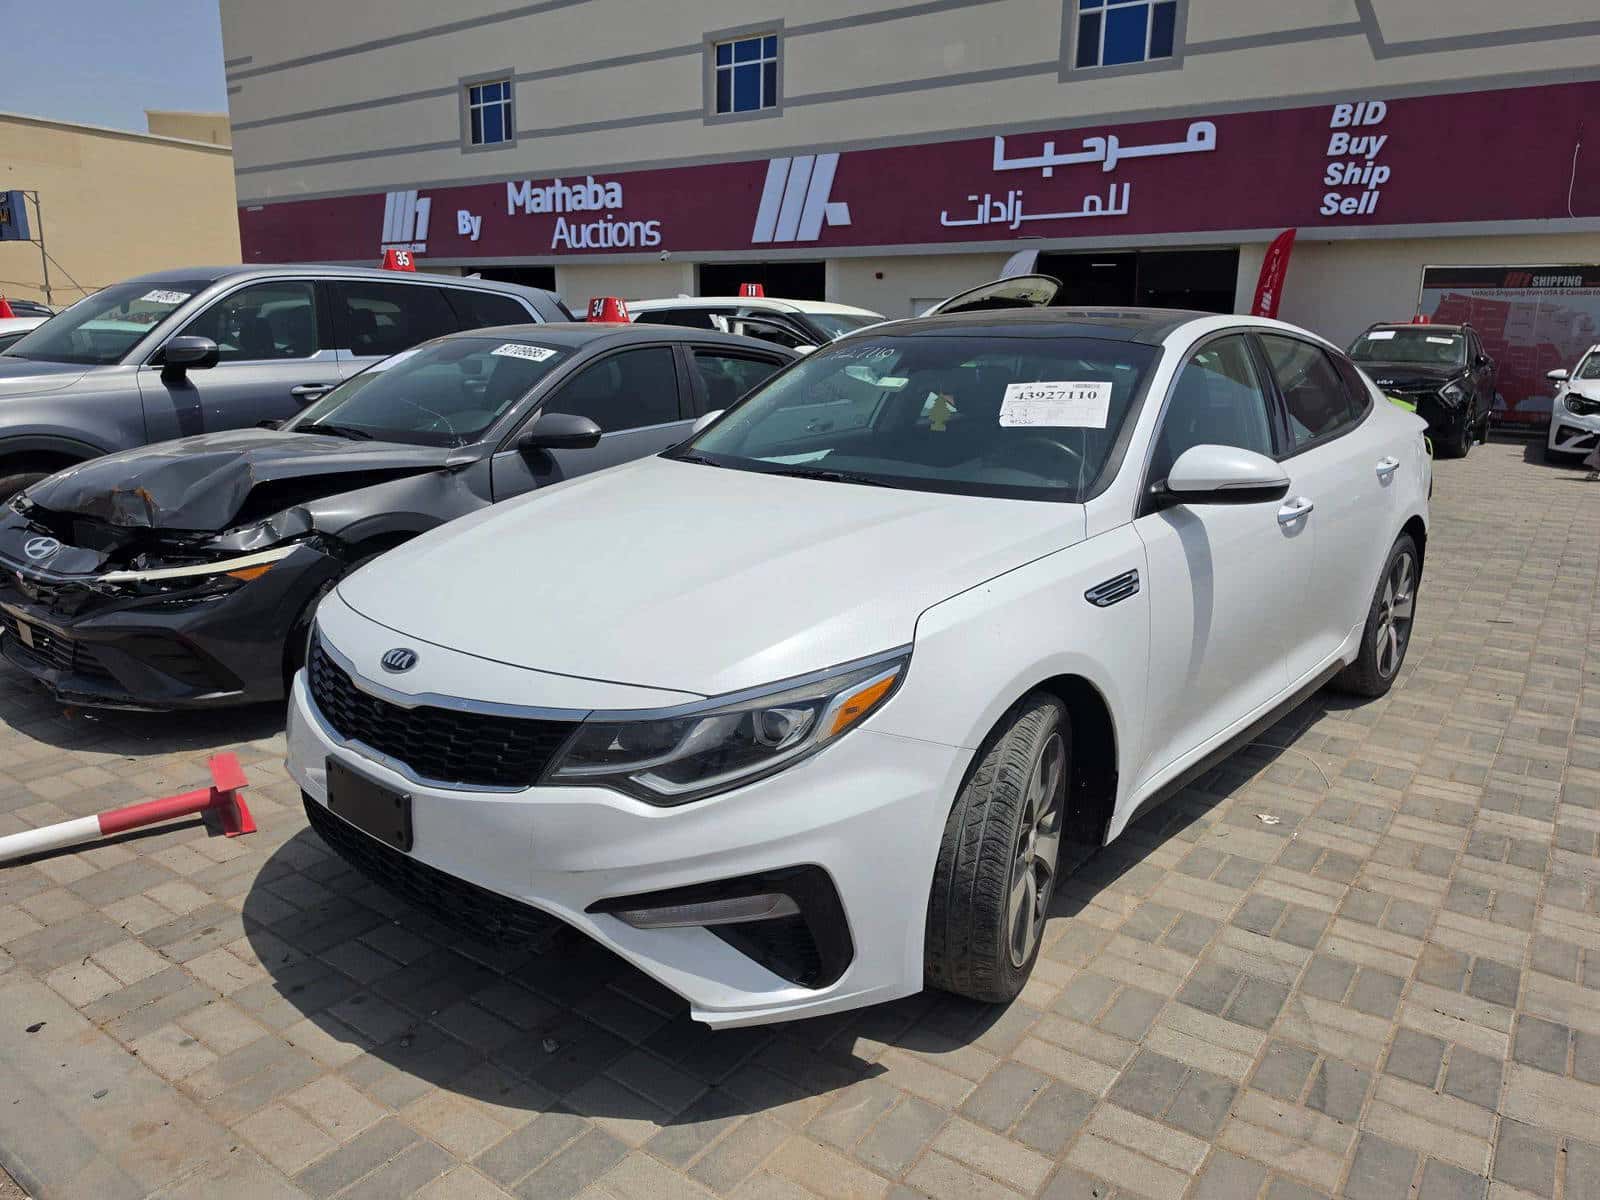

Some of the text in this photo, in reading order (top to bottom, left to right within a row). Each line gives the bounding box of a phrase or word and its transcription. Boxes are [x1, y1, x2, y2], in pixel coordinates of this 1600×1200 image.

[1330, 100, 1387, 128] BID
[992, 121, 1217, 177] مرحبا
[1326, 132, 1388, 159] Buy
[1323, 162, 1391, 189] Ship
[506, 175, 623, 215] Marhaba
[940, 183, 1131, 230] للمزادات
[1320, 191, 1380, 216] Sell
[457, 209, 482, 241] By
[551, 214, 662, 249] Auctions
[395, 250, 410, 266] 35
[1531, 275, 1583, 287] SHIPPING
[592, 299, 604, 317] 34
[1014, 390, 1098, 400] 43927110
[383, 649, 413, 669] KIA
